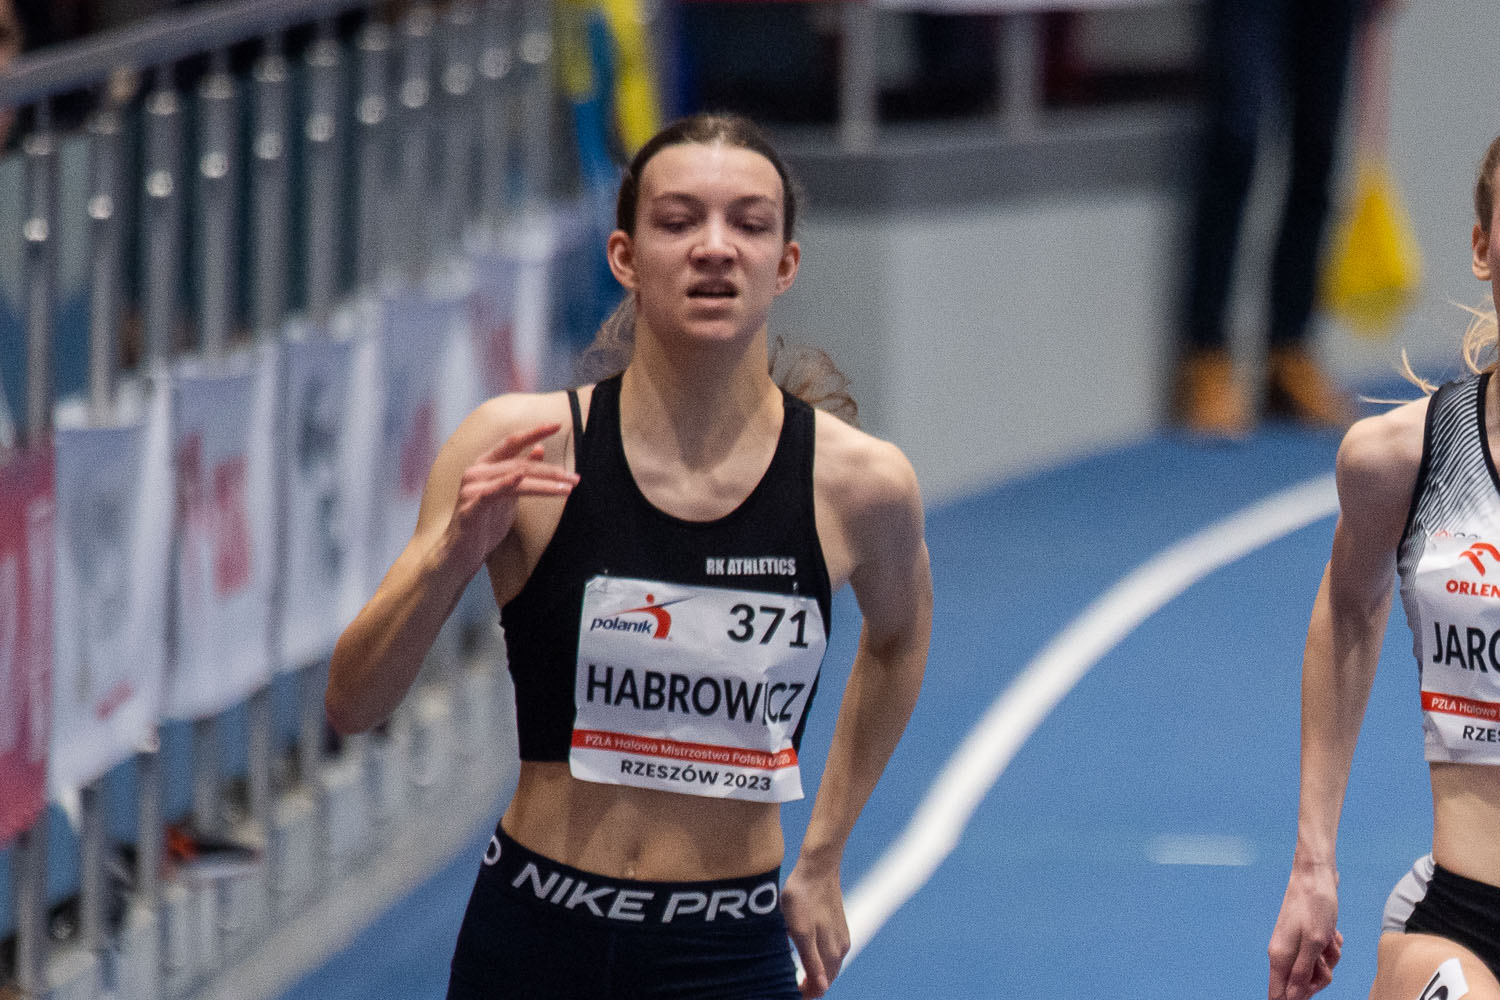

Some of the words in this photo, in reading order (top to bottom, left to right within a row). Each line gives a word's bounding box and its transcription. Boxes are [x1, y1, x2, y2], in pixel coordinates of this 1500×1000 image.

[706, 557, 725, 576] RK
[727, 557, 797, 577] ATHLETICS
[590, 617, 653, 634] polanik
[727, 603, 810, 650] 371
[586, 664, 805, 726] HABROWICZ
[1432, 698, 1457, 711] PZLA
[1459, 703, 1497, 718] Halowe
[614, 739, 658, 754] Halowe
[660, 744, 730, 762] Mistrzostwa
[732, 752, 767, 767] Polski
[620, 759, 719, 786] RZESZÓW
[723, 772, 772, 792] 2023
[511, 862, 655, 923] NIKE
[661, 881, 778, 924] PRO
